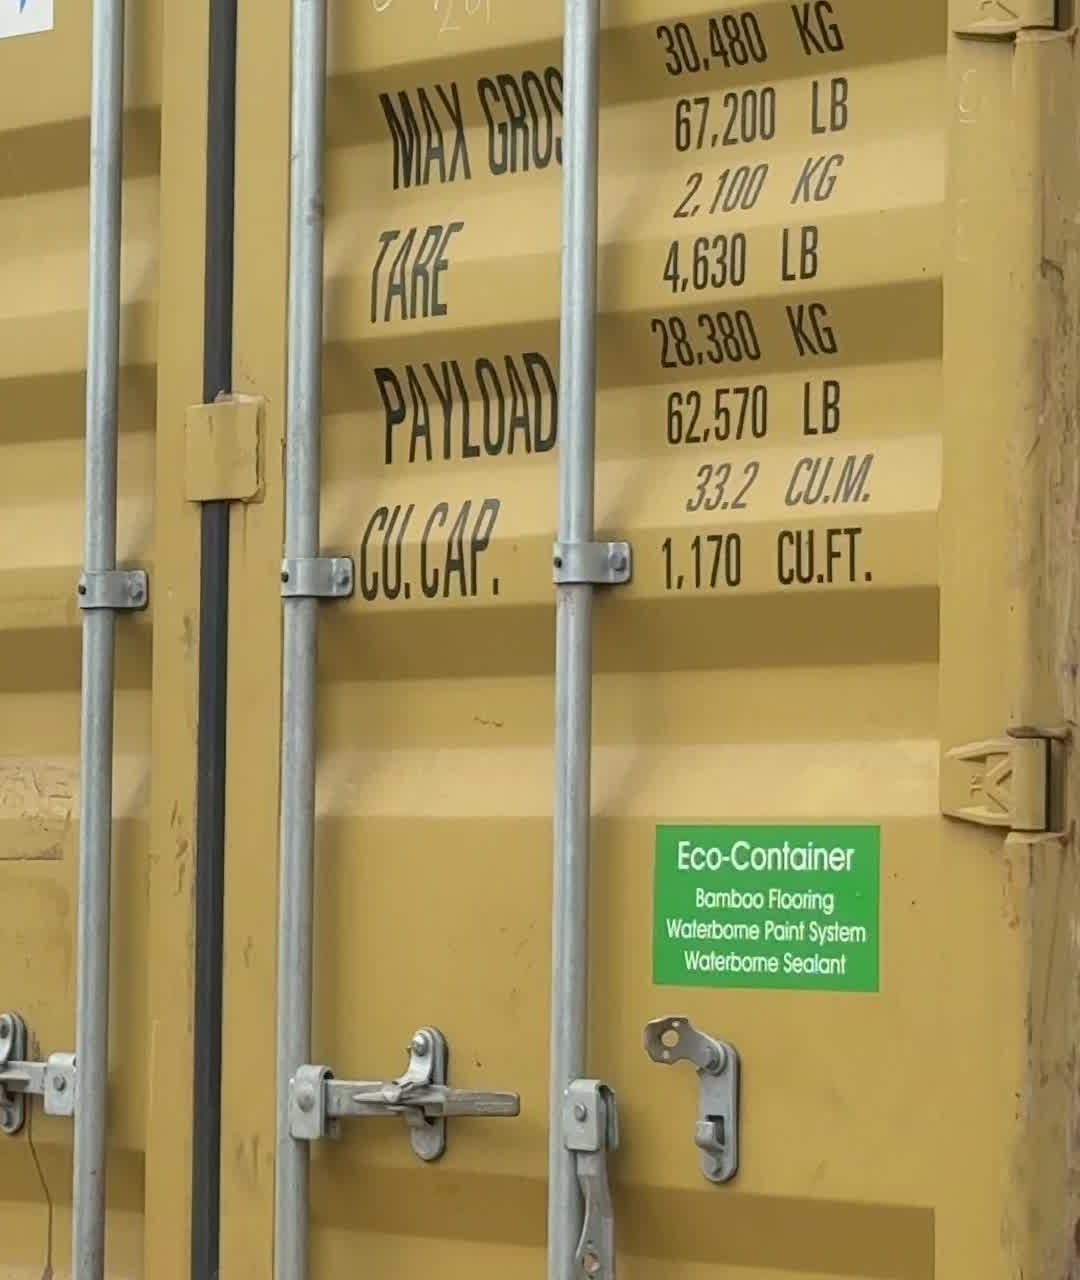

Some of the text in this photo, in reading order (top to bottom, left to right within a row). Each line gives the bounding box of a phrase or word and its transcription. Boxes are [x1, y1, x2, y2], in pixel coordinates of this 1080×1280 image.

[380, 83, 471, 189] MAX
[479, 74, 564, 177] GROS
[792, 0, 844, 55] KG
[674, 77, 848, 152] 67,200 LB
[370, 154, 844, 323] TARE 2,100 KG
[663, 225, 818, 293] 4,630 LB
[374, 352, 558, 465] PAYLOAD
[786, 303, 838, 357] KG
[667, 380, 841, 446] 62,570 LB
[686, 461, 759, 513] 33.2
[785, 454, 874, 507] CU.M.
[777, 527, 872, 585] CU.FT.
[678, 841, 854, 871] Eco-Container
[667, 919, 866, 946] Waterborne Paint System
[696, 888, 834, 915] Bamboo Flooring
[684, 951, 846, 975] Waterborne Sealant
